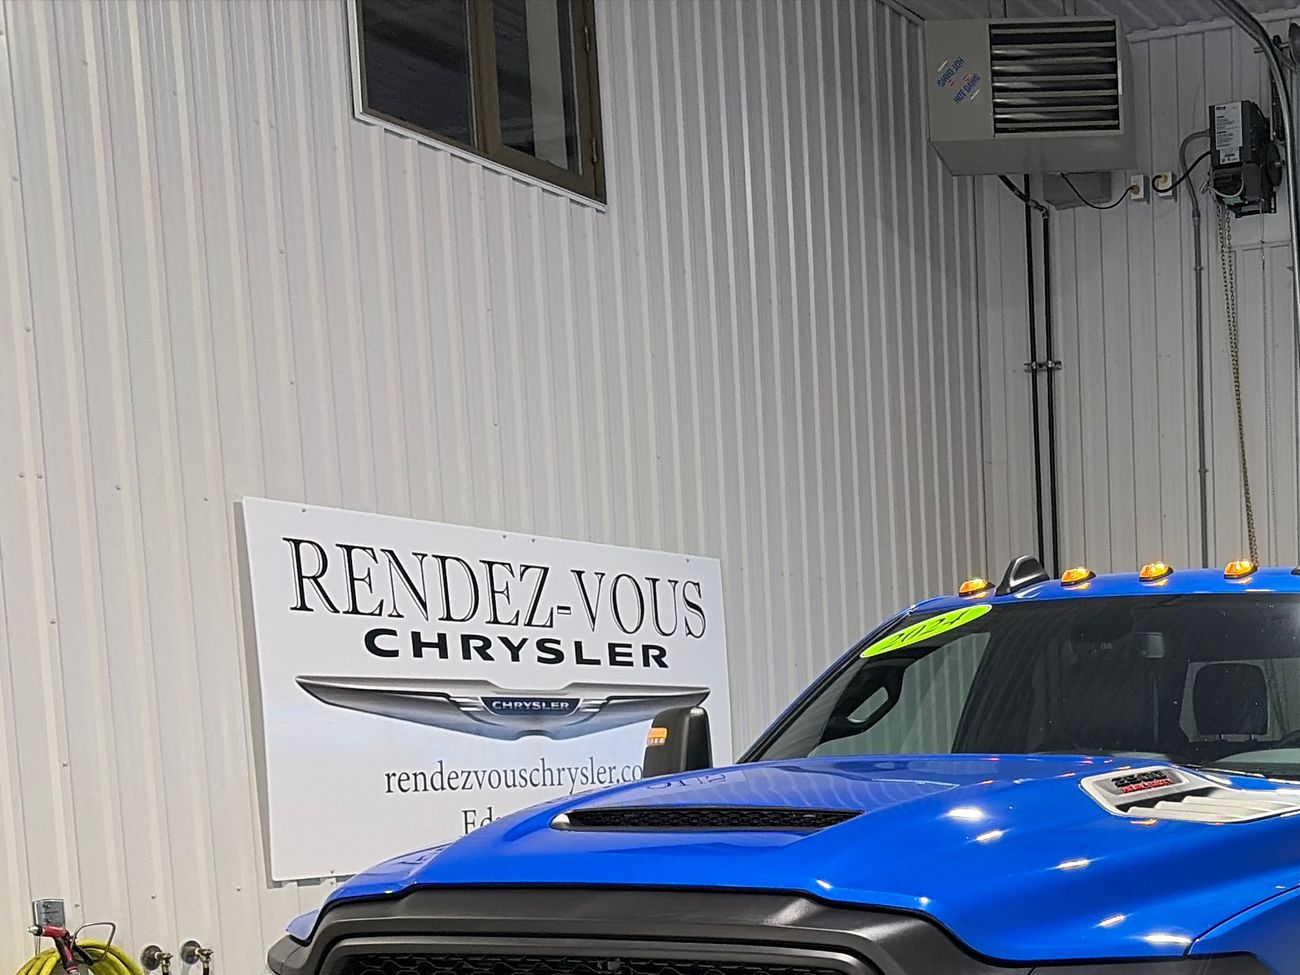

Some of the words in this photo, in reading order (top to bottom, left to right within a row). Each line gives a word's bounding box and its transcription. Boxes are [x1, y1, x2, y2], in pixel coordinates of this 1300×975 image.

[282, 536, 707, 639] RENDEZ-VOUS
[364, 628, 669, 668] CHRYSLER
[492, 701, 570, 710] CHRYSLER
[385, 757, 643, 795] rendezvouschrysler.co
[461, 806, 501, 835] Ed
